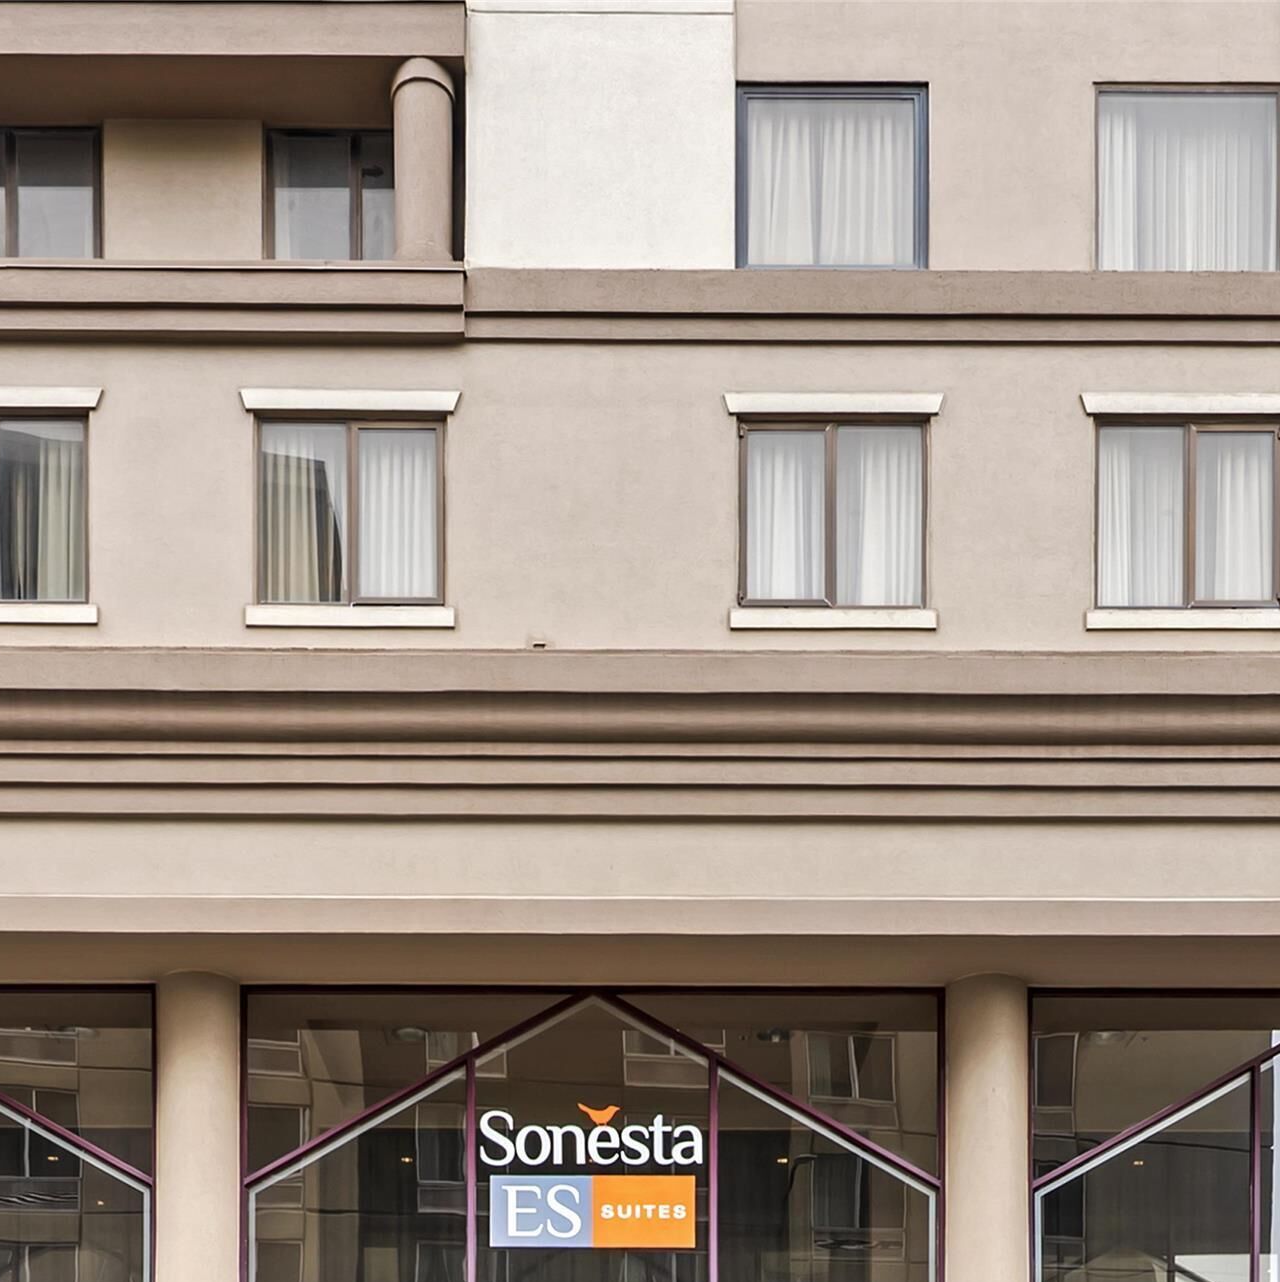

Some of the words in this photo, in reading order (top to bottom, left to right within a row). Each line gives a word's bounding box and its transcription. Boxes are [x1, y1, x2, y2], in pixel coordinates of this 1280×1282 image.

[479, 1109, 704, 1167] Sonesta
[501, 1184, 583, 1239] ES
[600, 1203, 688, 1220] SUITES
